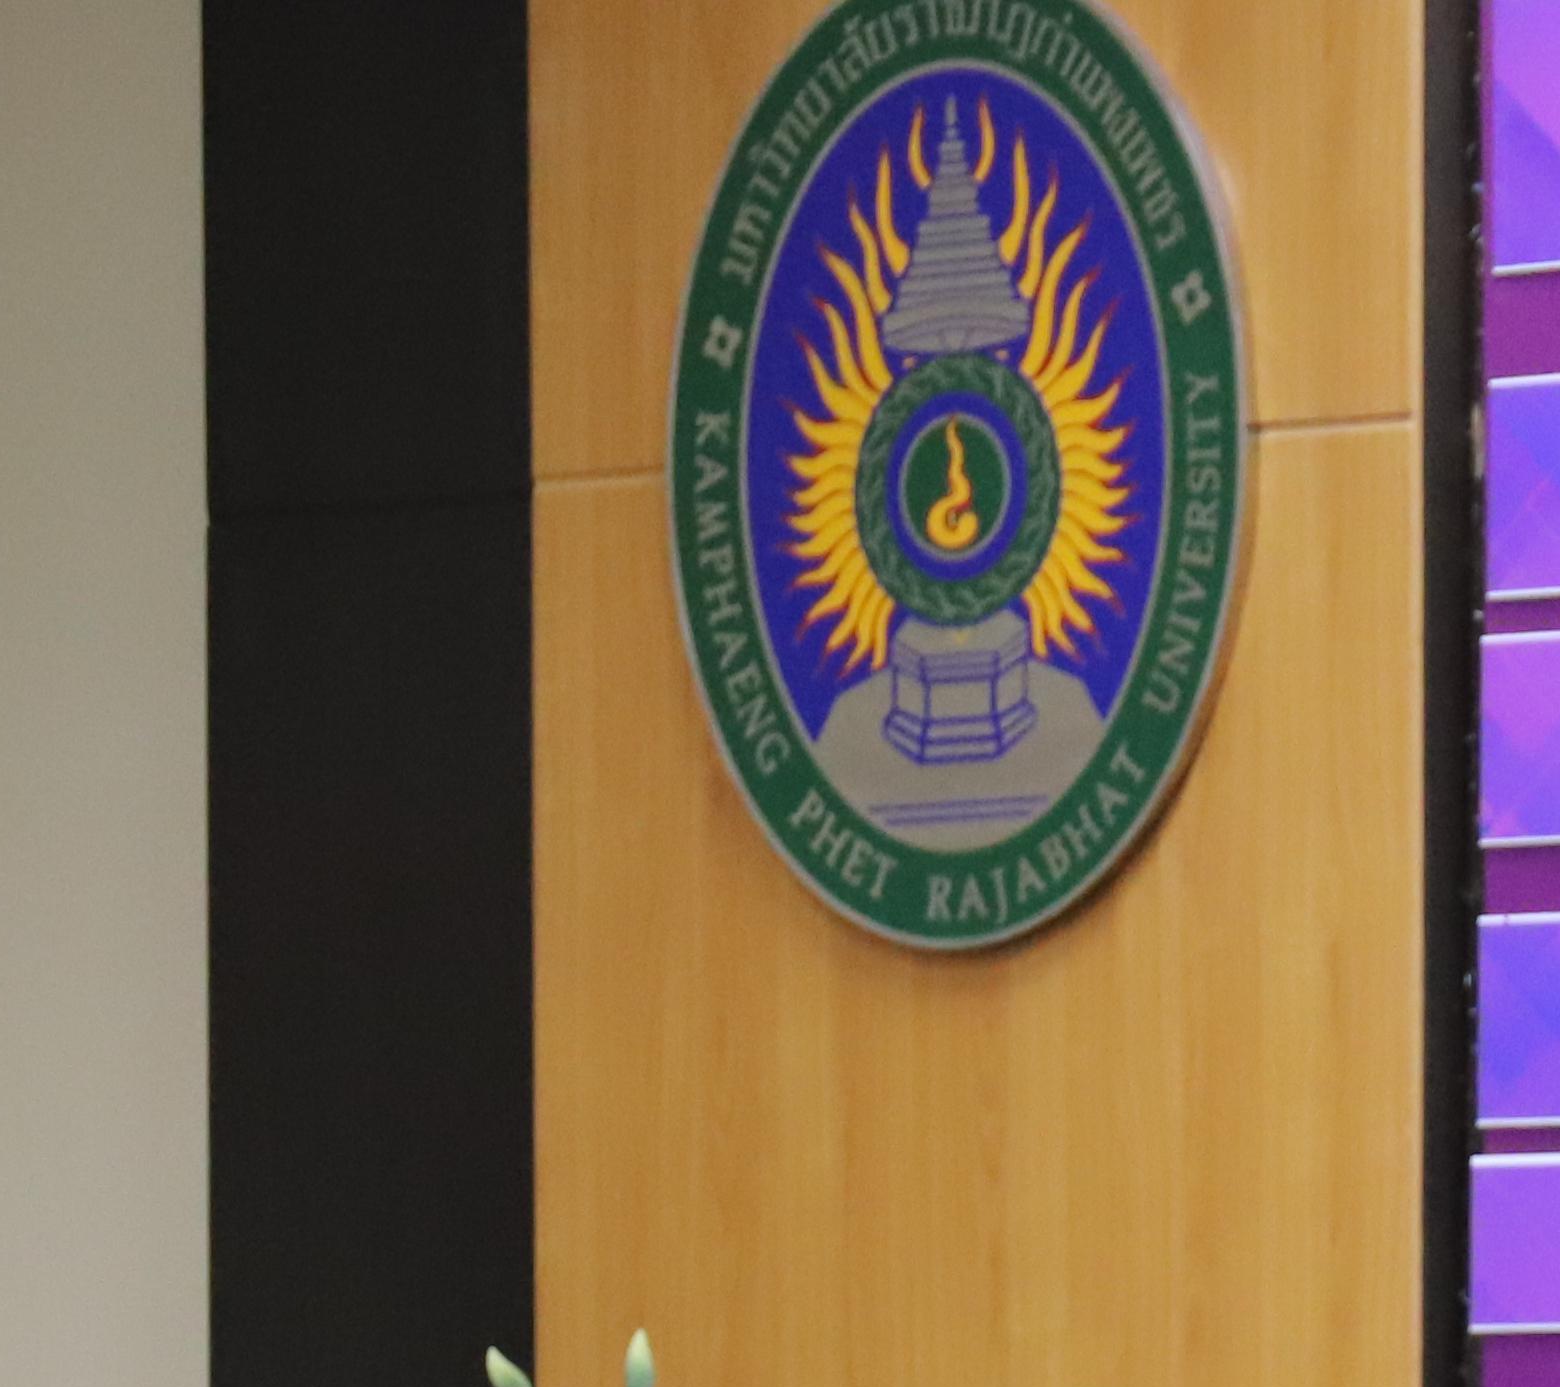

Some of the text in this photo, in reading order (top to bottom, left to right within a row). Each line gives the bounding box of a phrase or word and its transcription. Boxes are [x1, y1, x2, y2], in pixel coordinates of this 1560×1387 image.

[694, 371, 1223, 925] KAMPHAENG PHET RAJABHAT UNIVERSITY
